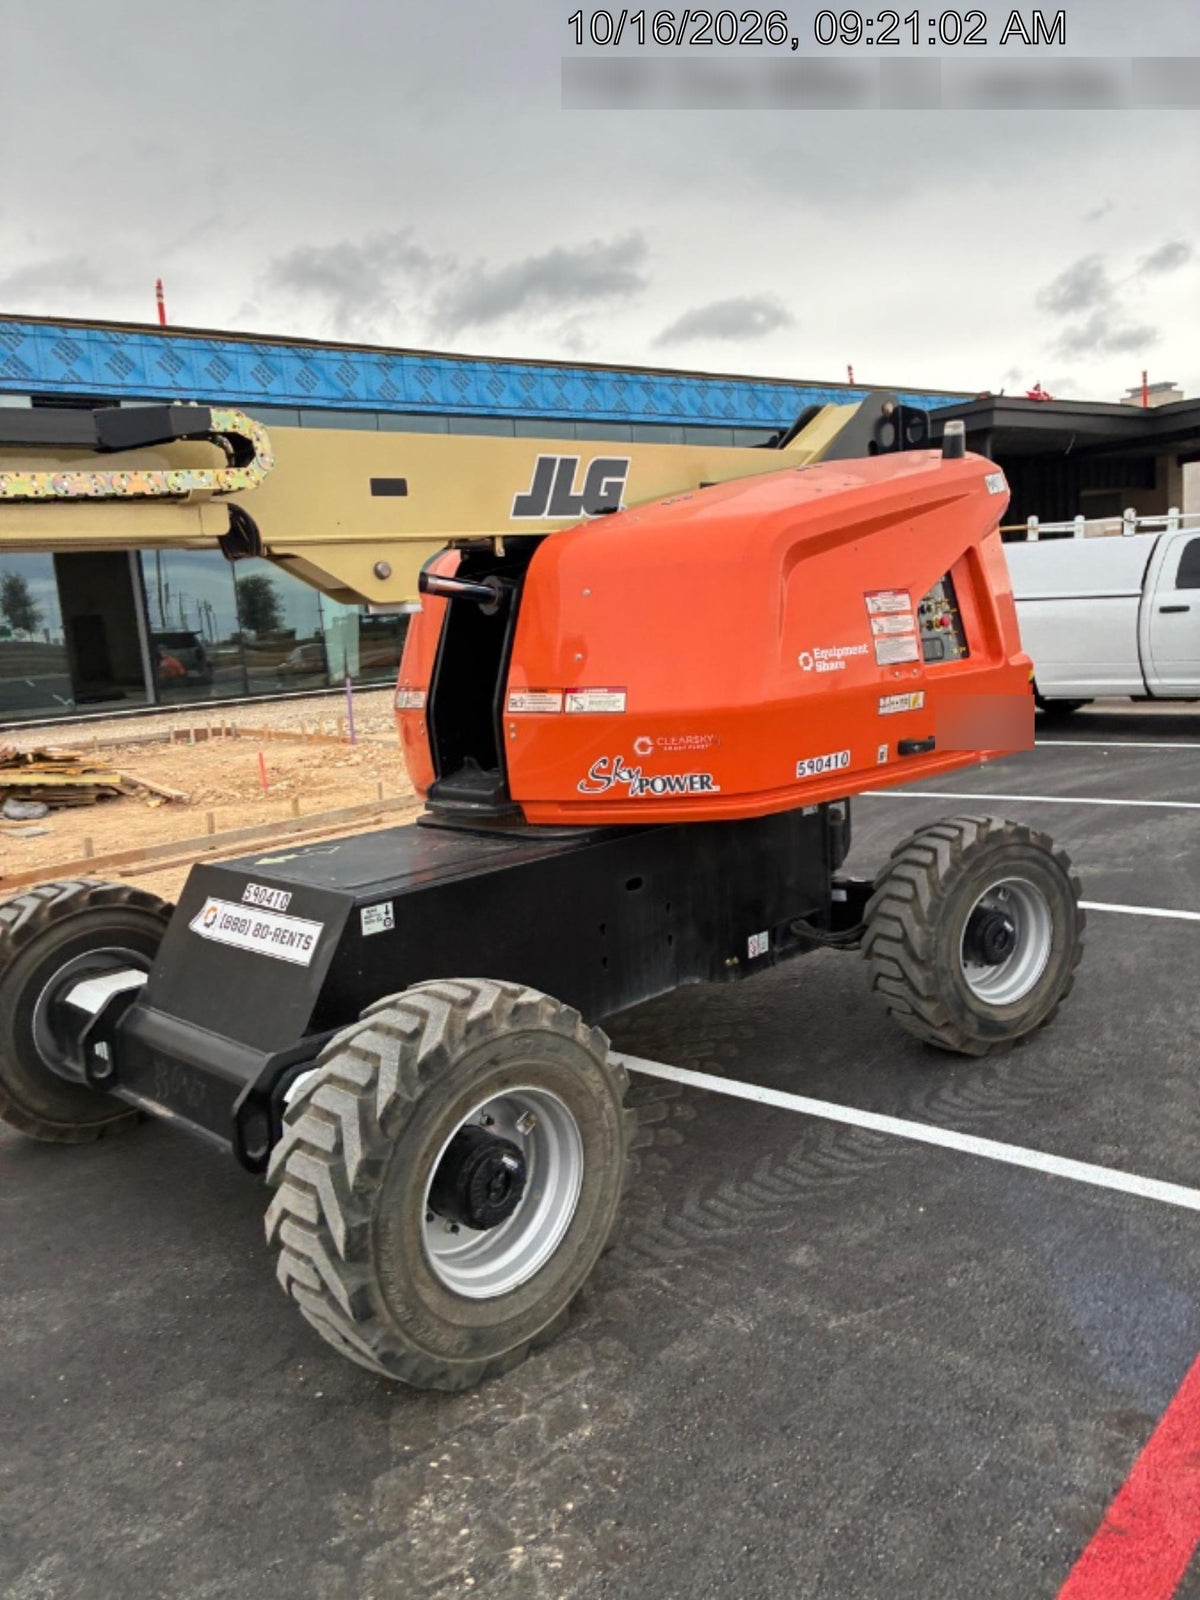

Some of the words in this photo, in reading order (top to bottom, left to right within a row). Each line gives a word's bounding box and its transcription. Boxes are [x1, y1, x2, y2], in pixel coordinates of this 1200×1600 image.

[510, 454, 631, 520] JLG
[813, 643, 868, 660] Equipment
[815, 661, 845, 672] Share
[656, 734, 714, 746] CLEARSKY
[796, 751, 850, 777] 590410
[243, 884, 291, 910] 590410
